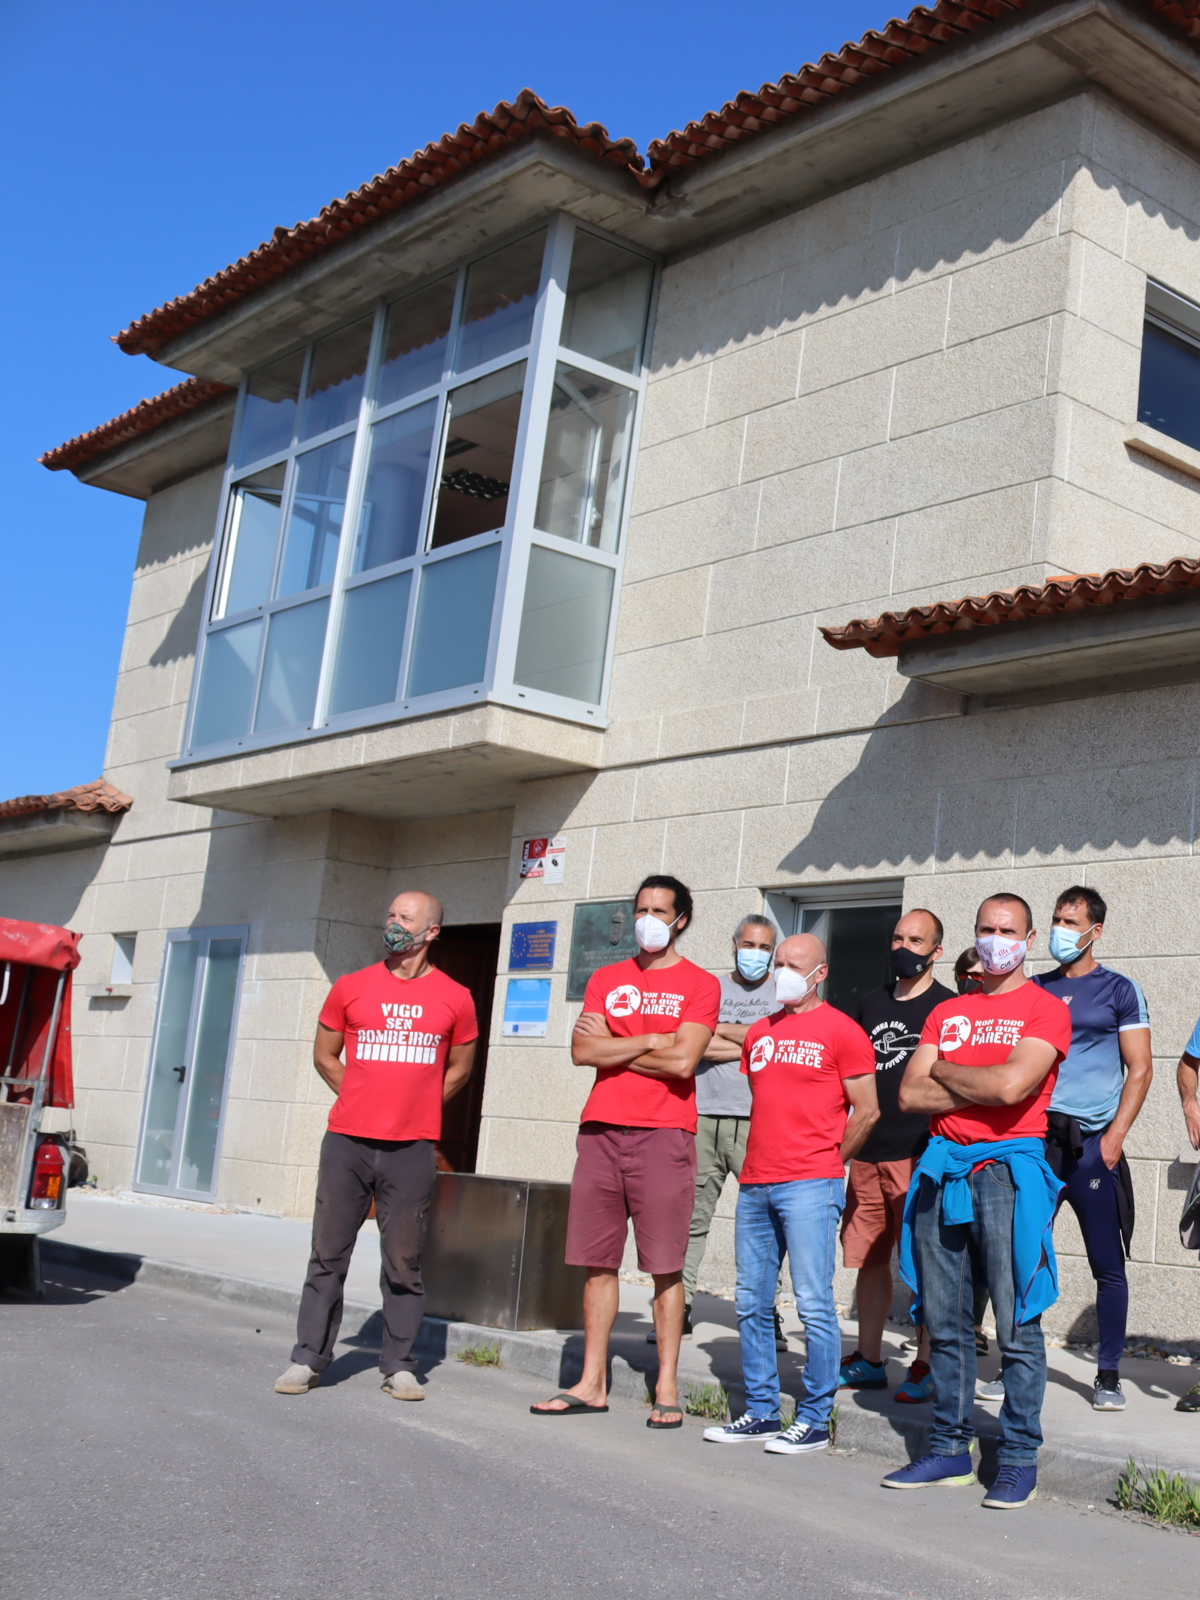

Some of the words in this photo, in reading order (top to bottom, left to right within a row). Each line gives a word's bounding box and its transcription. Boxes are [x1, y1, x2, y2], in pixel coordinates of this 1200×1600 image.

[661, 993, 685, 1001] TODO
[381, 1003, 423, 1018] VIGO
[386, 1018, 413, 1030] SEN
[998, 1019, 1024, 1027] TODO
[995, 1025, 1020, 1034] QUE
[358, 1030, 441, 1047] BOMBEIROS
[971, 1032, 1021, 1046] PARECE
[799, 1040, 825, 1051] TODO
[797, 1047, 821, 1057] QUE
[774, 1052, 823, 1069] PARECE
[885, 1050, 908, 1070] FUTURO
